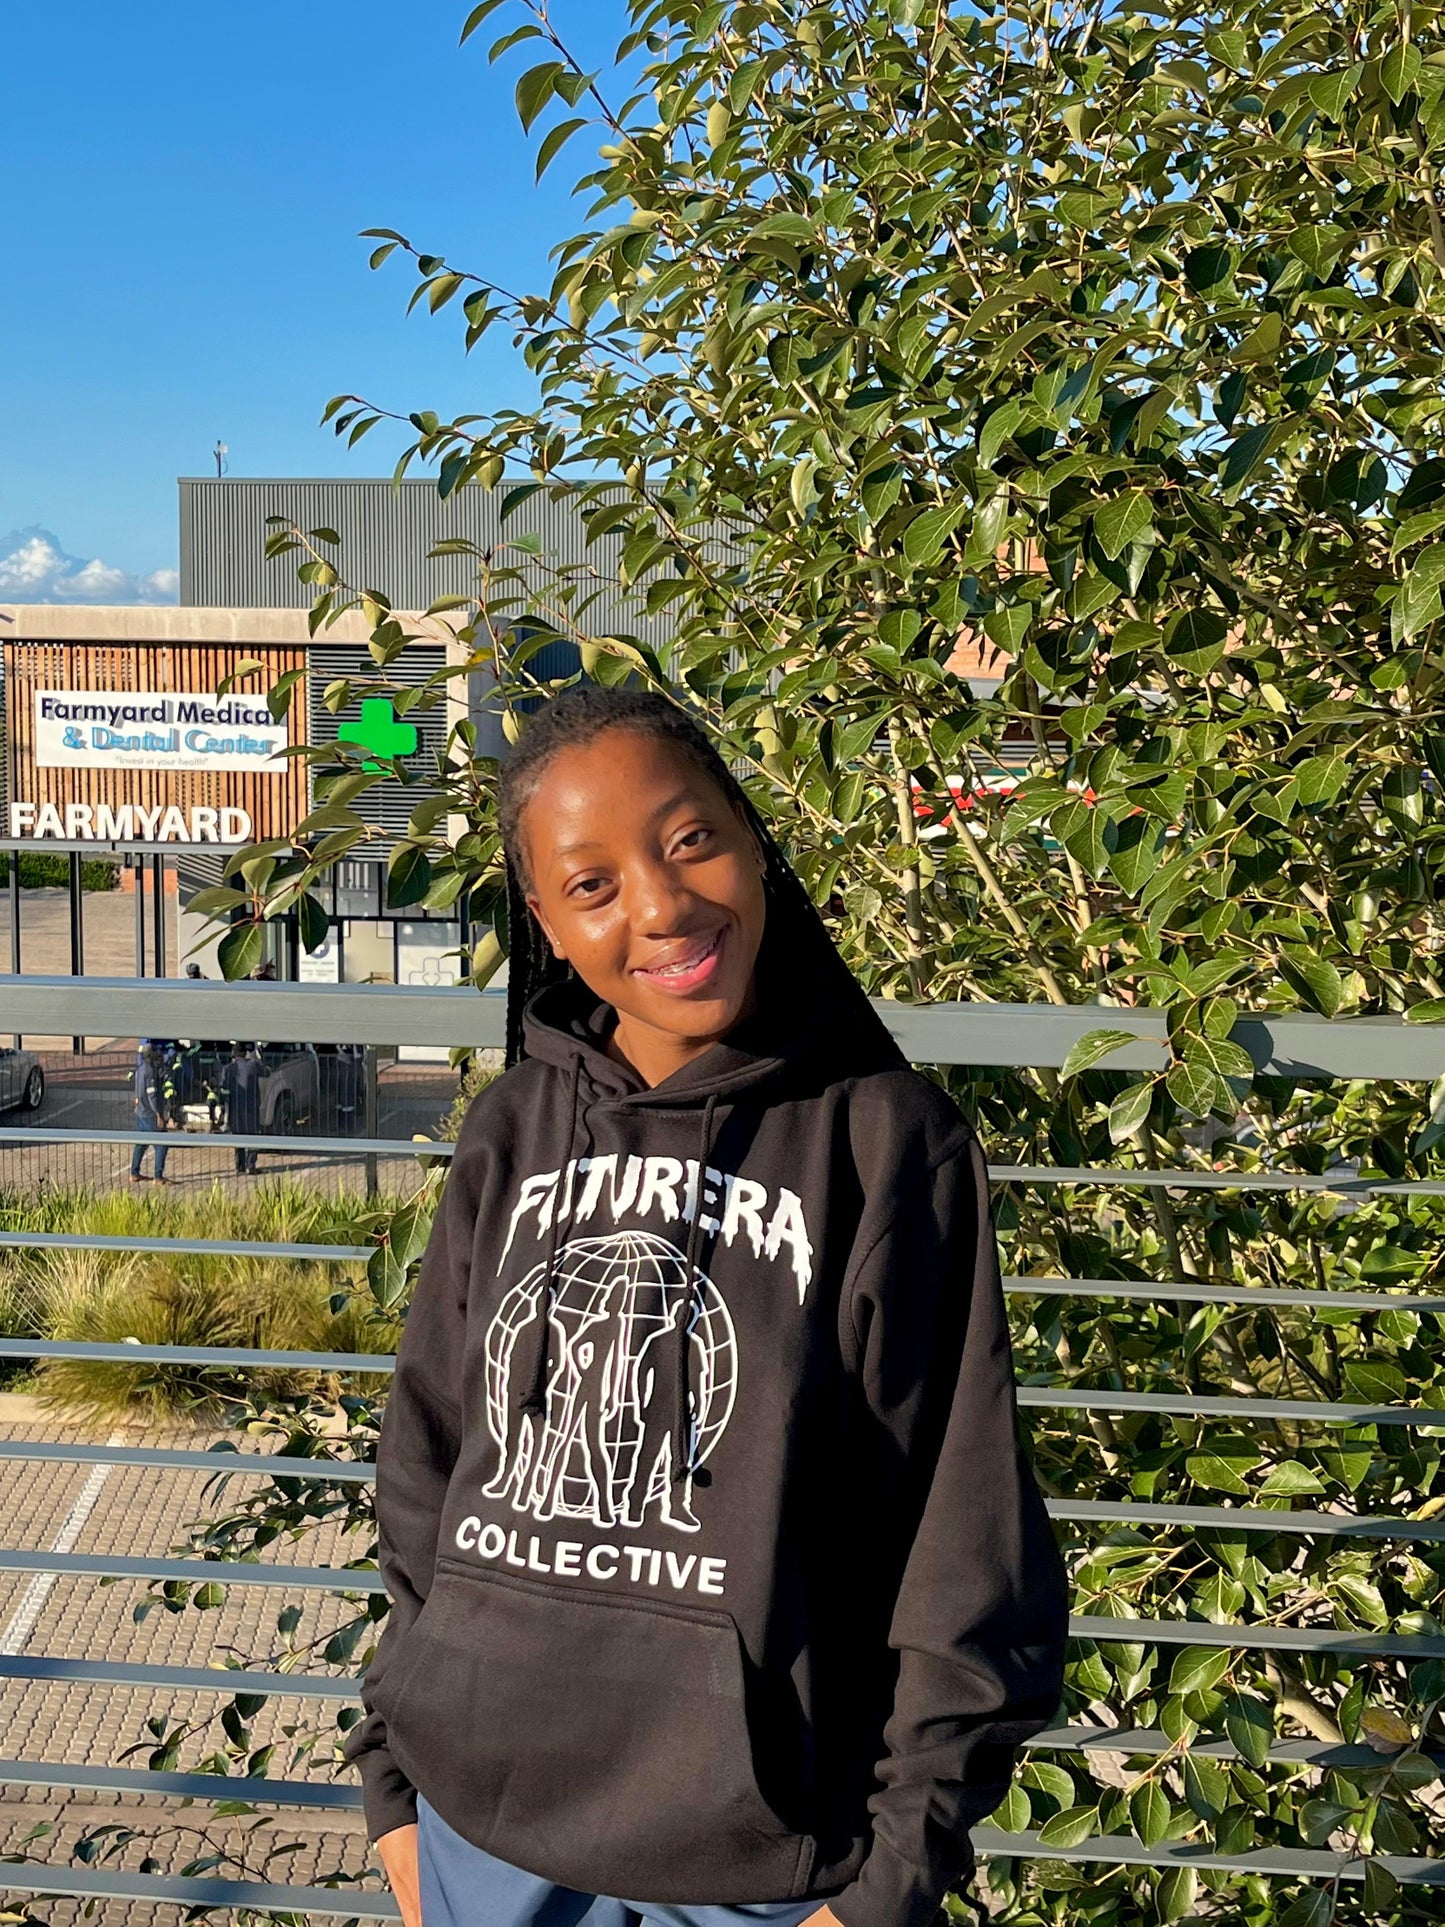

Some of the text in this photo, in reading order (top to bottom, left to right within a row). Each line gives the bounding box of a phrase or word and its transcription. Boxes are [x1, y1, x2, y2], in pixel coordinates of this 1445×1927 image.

[41, 697, 272, 727] Farmyard Medica
[62, 726, 272, 755] & Dental Center
[157, 758, 176, 767] your
[10, 802, 252, 844] FARMYARD
[496, 1153, 814, 1306] FUTURERA
[455, 1515, 728, 1596] COLLECTIVE
